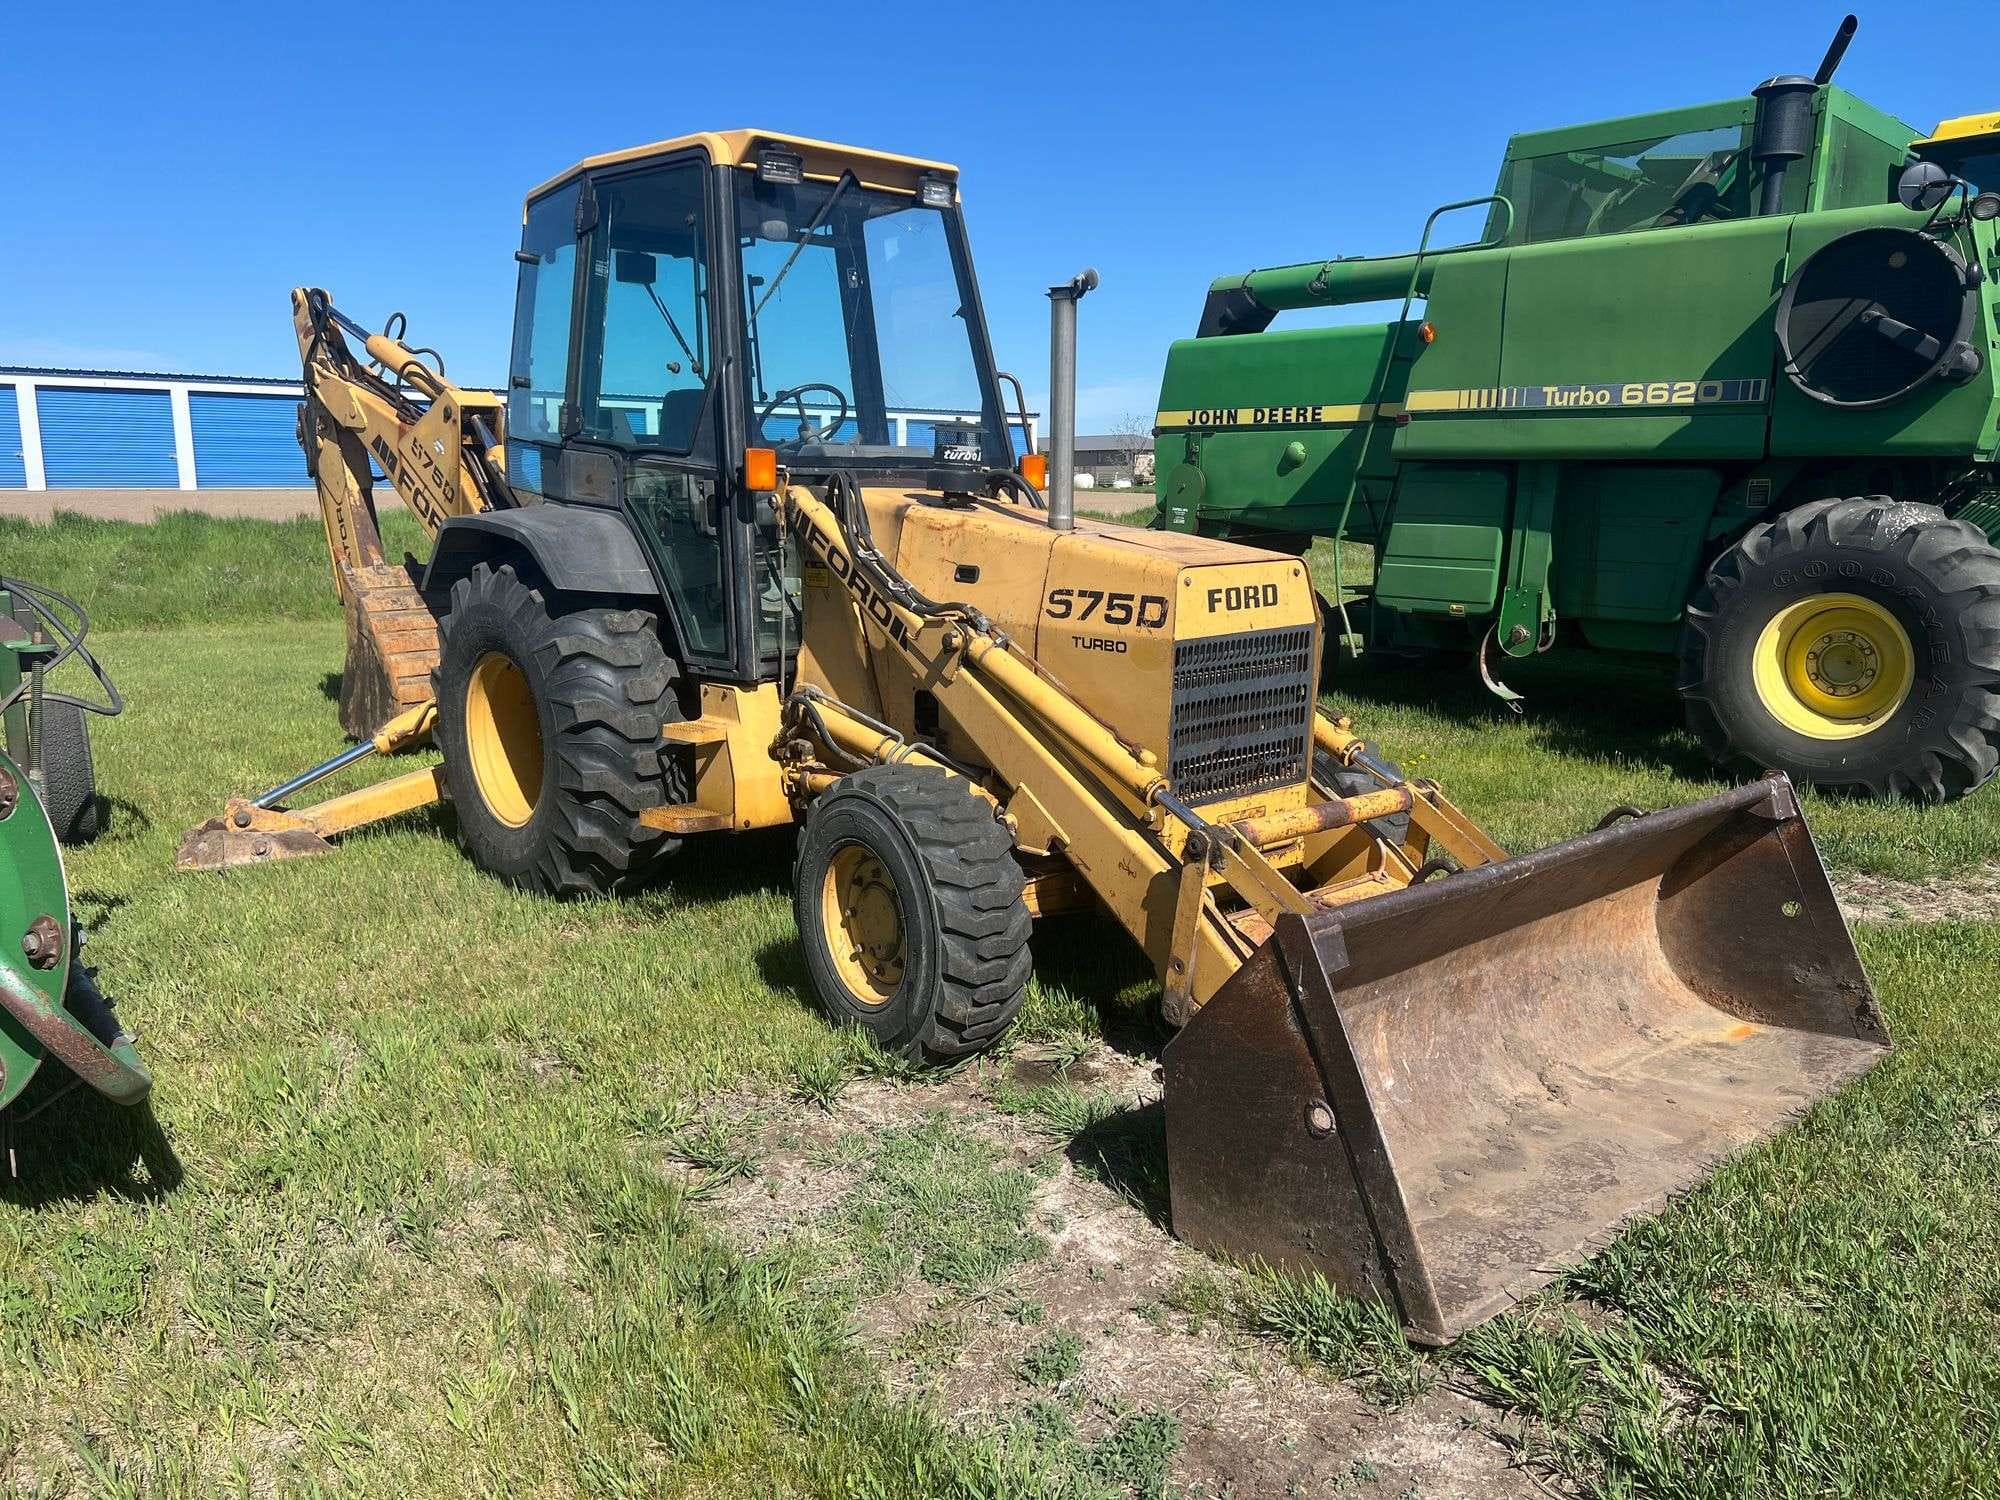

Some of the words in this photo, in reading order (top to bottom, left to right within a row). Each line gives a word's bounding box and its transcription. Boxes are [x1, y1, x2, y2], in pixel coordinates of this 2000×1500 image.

[1543, 386, 1611, 406] Turbo
[1621, 381, 1723, 405] 6620
[1187, 408, 1238, 425] JOHN
[1253, 406, 1323, 423] DEERE
[807, 522, 893, 628] FORD
[1207, 583, 1279, 613] FORD
[1072, 635, 1128, 654] TURBO
